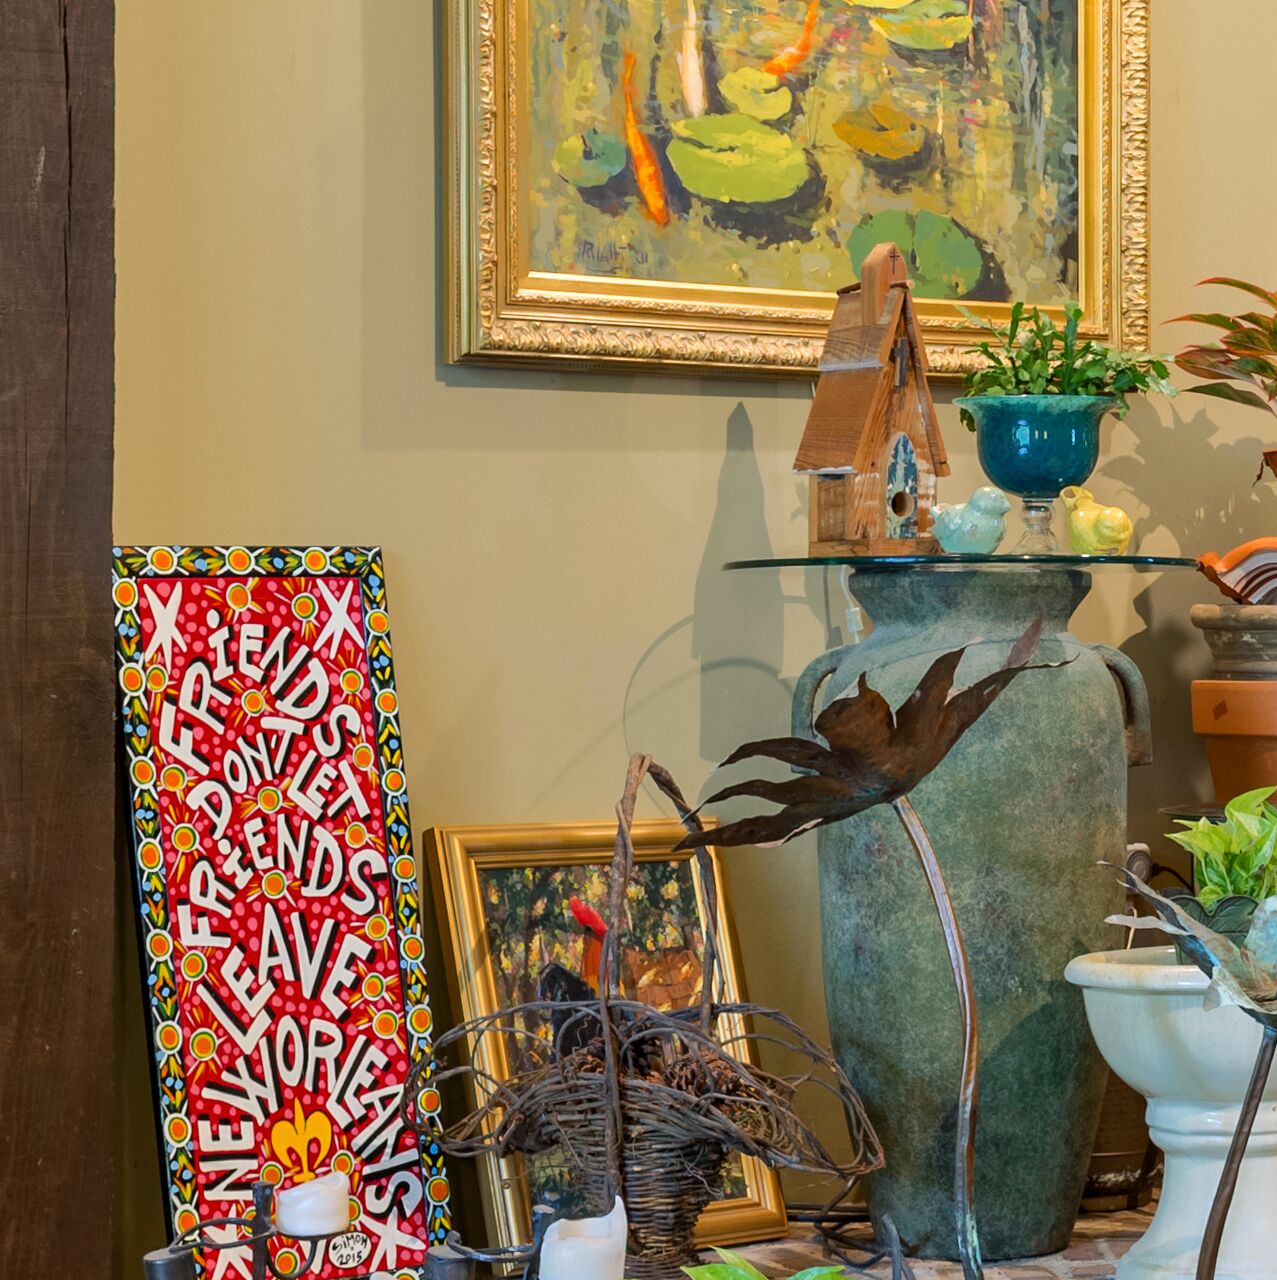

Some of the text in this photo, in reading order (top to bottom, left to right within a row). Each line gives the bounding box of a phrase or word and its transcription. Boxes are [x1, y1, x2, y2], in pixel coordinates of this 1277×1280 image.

[159, 609, 362, 777] FRIENDS
[186, 716, 372, 840] DON'T LET
[176, 813, 388, 949] FRIENDS
[196, 903, 375, 1055] LEAVE
[197, 1015, 424, 1219] NEW ORLEANS
[337, 1251, 363, 1266] 2015
